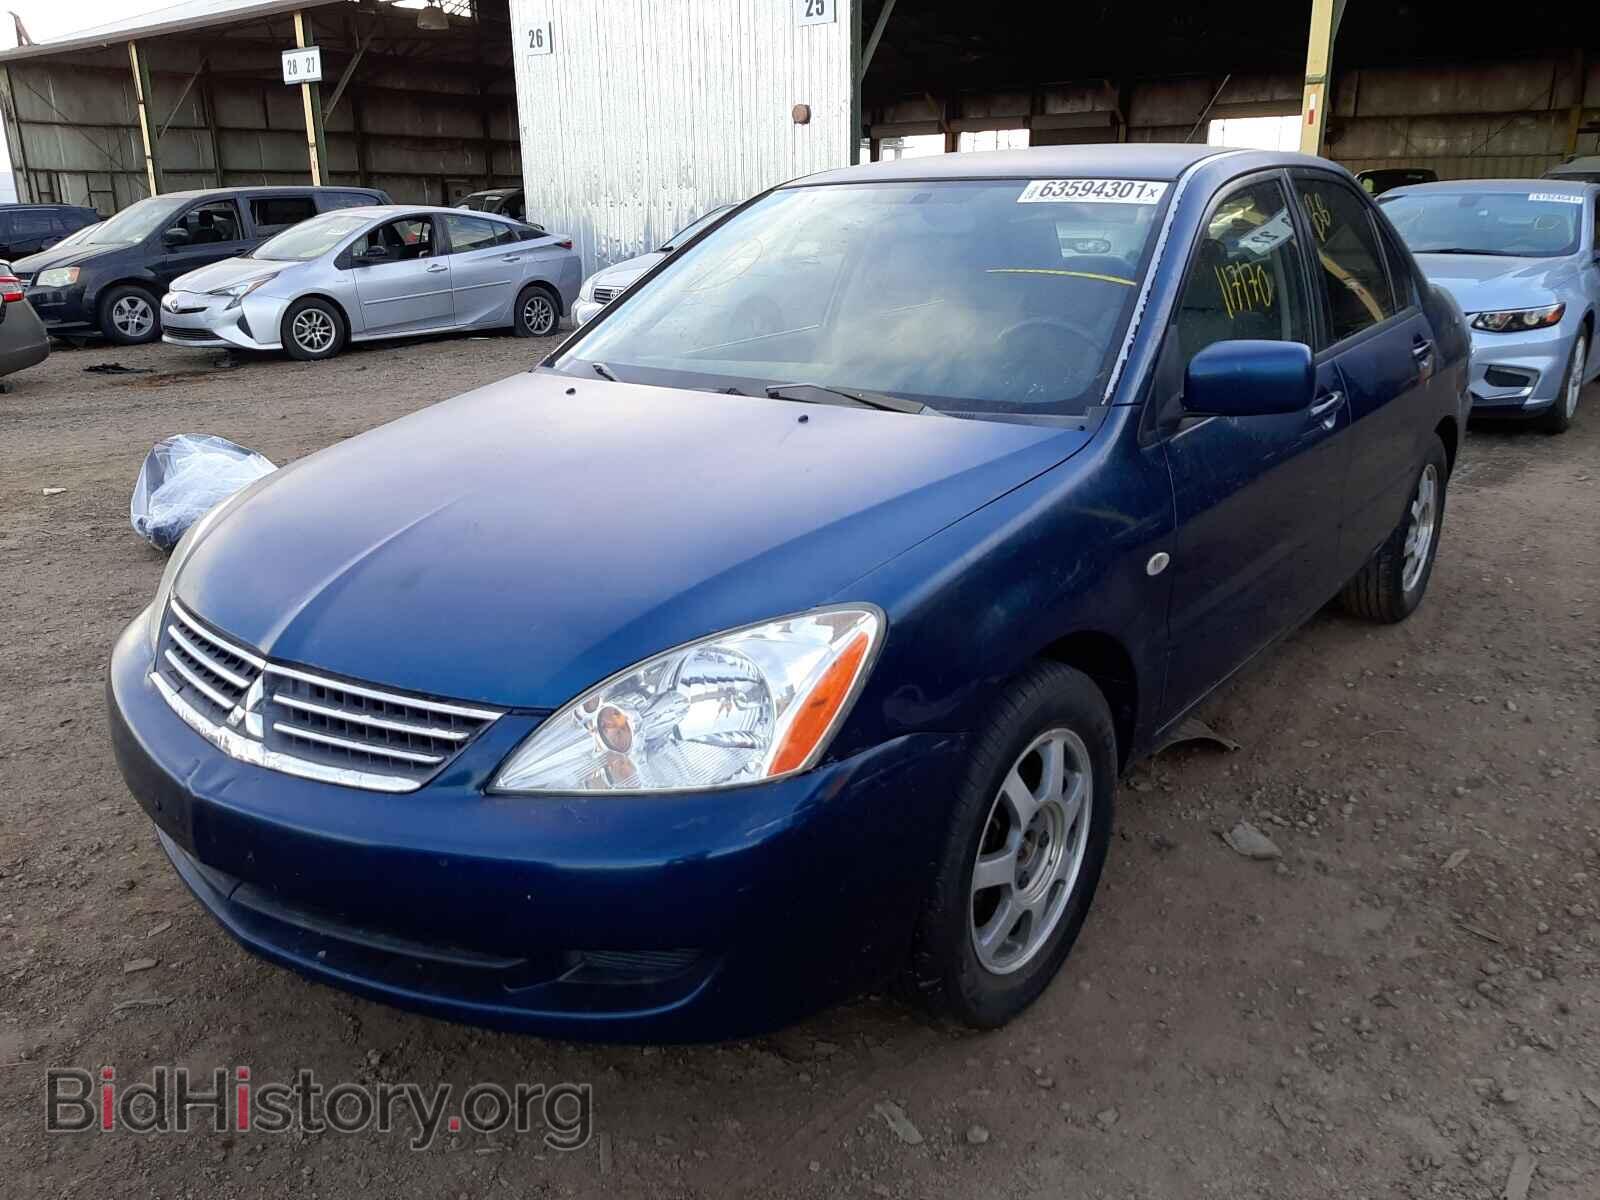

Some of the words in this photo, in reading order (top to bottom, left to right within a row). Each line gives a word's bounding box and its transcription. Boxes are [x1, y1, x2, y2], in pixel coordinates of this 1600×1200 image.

[804, 0, 825, 17] 25
[528, 28, 544, 49] 26
[287, 58, 298, 76] 28
[305, 56, 315, 73] 27
